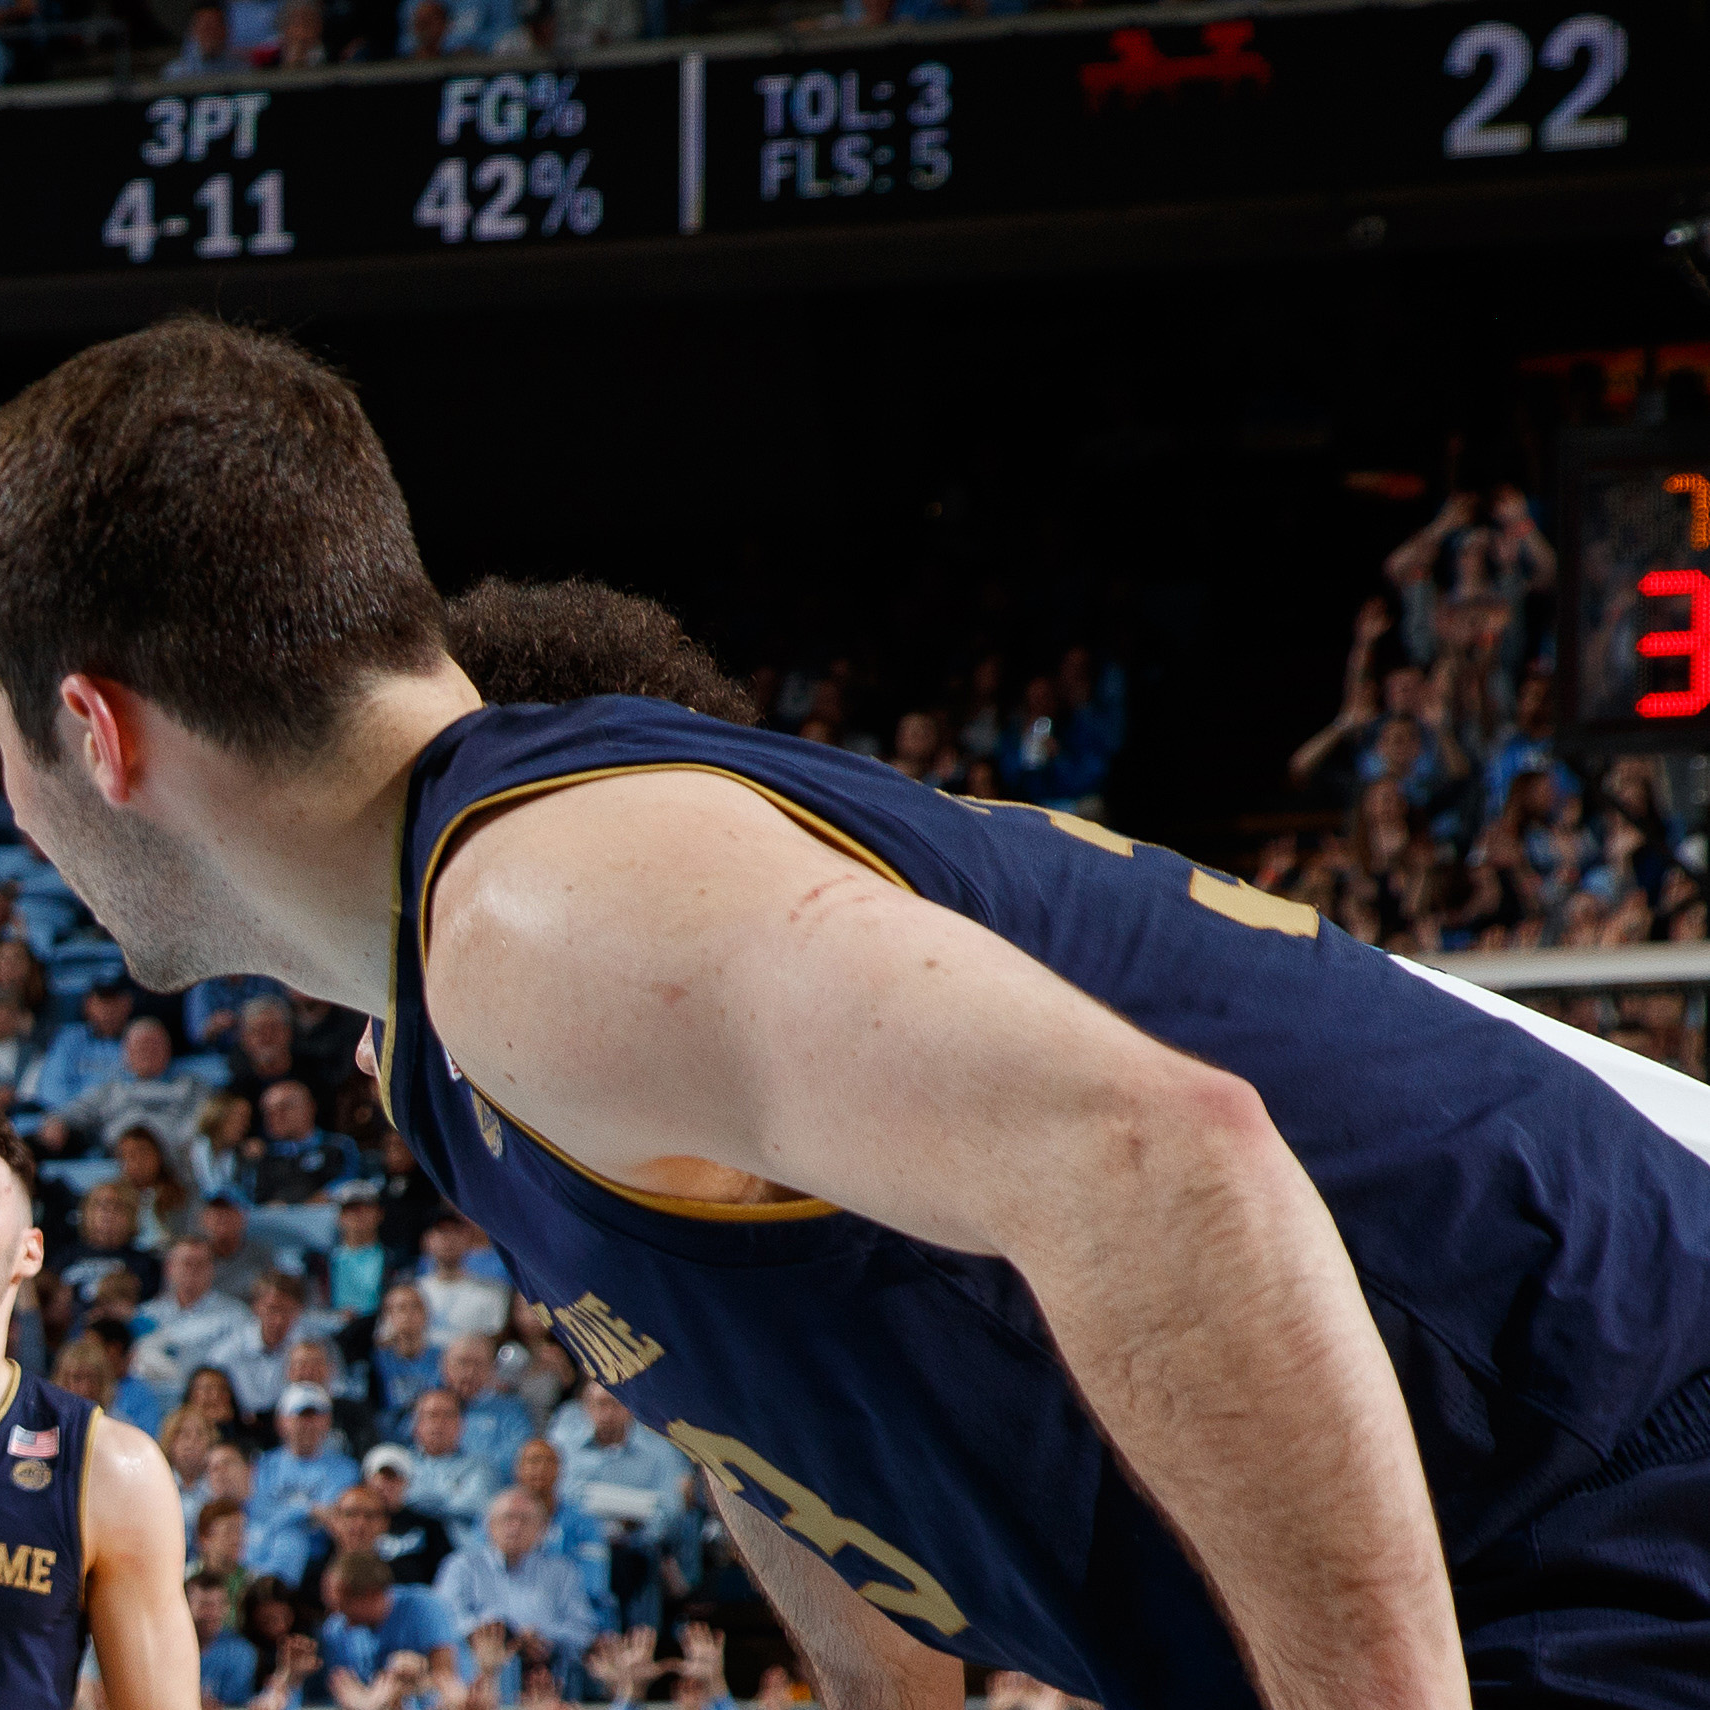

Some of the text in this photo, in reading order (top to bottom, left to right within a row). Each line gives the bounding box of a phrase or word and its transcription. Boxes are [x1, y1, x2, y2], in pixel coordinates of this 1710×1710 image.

[141, 93, 271, 165] 3PT
[437, 73, 585, 143] FG%
[757, 62, 953, 134] TOL: 3
[1443, 13, 1628, 159] 22
[102, 171, 295, 263] 4-11
[414, 151, 604, 242] 42%
[908, 132, 953, 189] 5
[1635, 569, 1710, 718] 3
